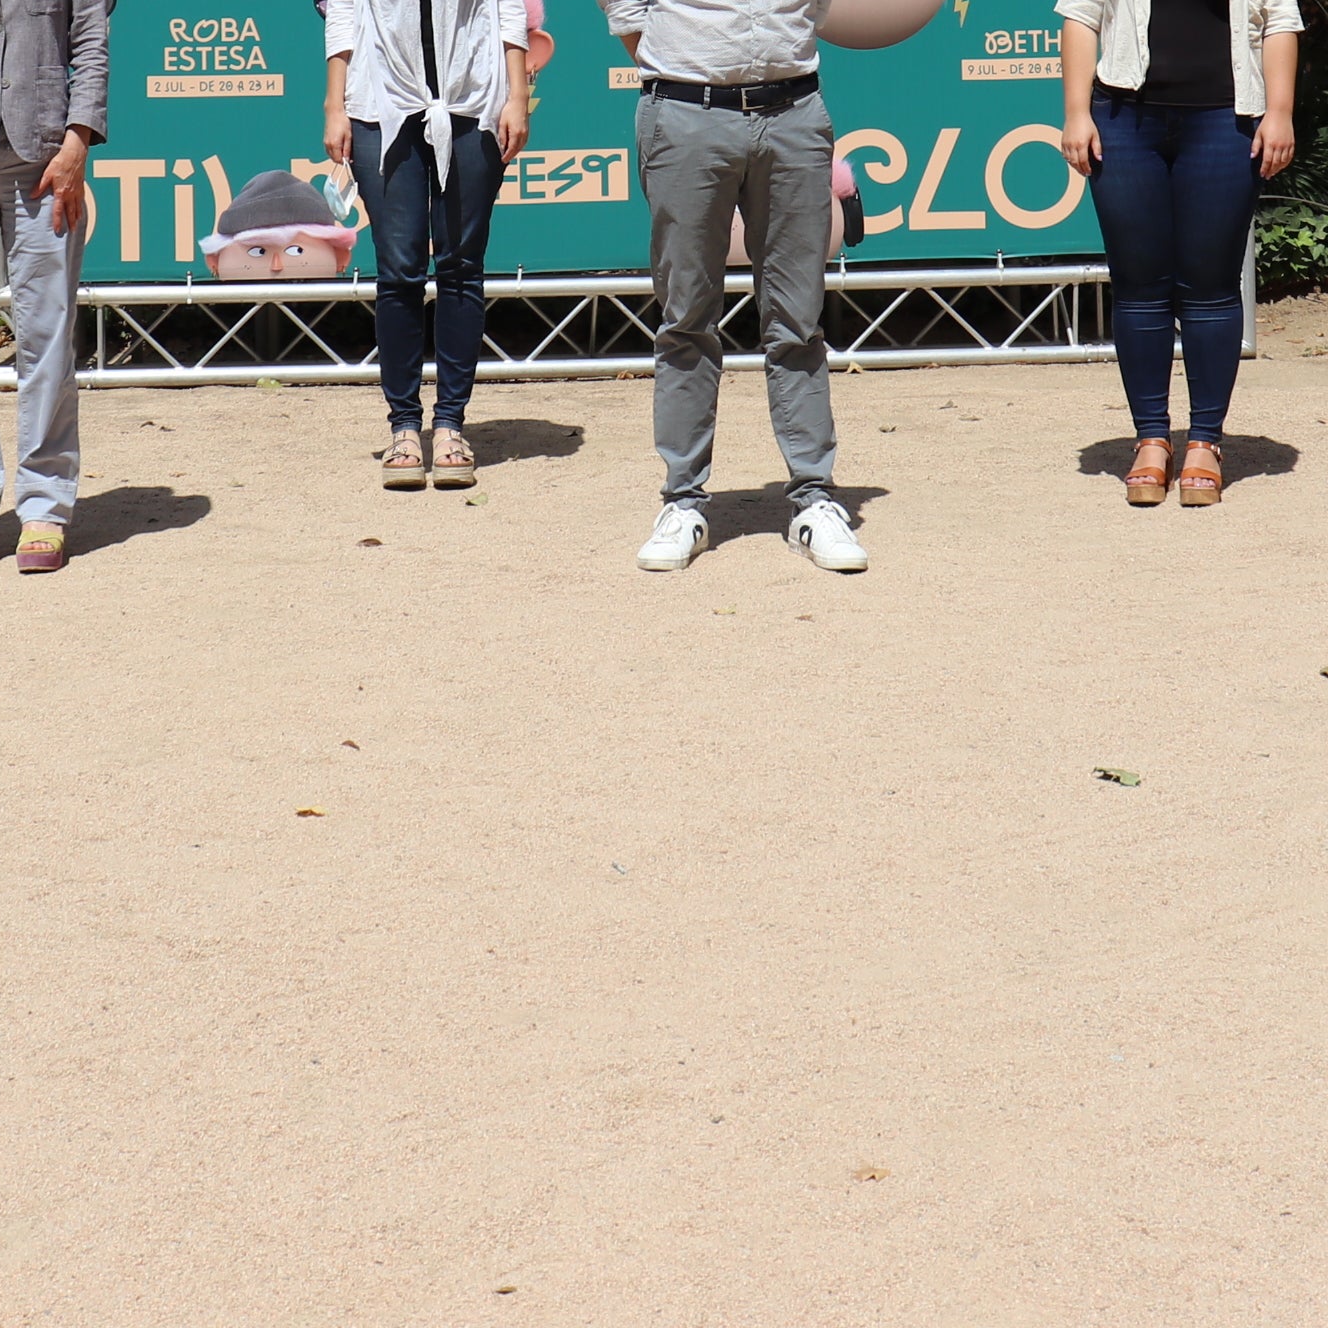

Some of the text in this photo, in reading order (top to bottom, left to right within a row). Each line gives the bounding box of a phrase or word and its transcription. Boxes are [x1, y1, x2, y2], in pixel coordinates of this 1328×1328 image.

[169, 17, 261, 43] ROBA
[985, 29, 1062, 54] BETH
[164, 46, 267, 71] ESTESA
[616, 72, 640, 84] 2 JU
[967, 64, 975, 75] 9
[1010, 63, 1025, 74] DE
[1028, 63, 1042, 74] 20
[1045, 63, 1052, 74] A
[154, 81, 161, 92] 2
[199, 80, 214, 92] DE
[219, 80, 233, 92] 20
[237, 81, 244, 92] A
[248, 80, 262, 92] 23
